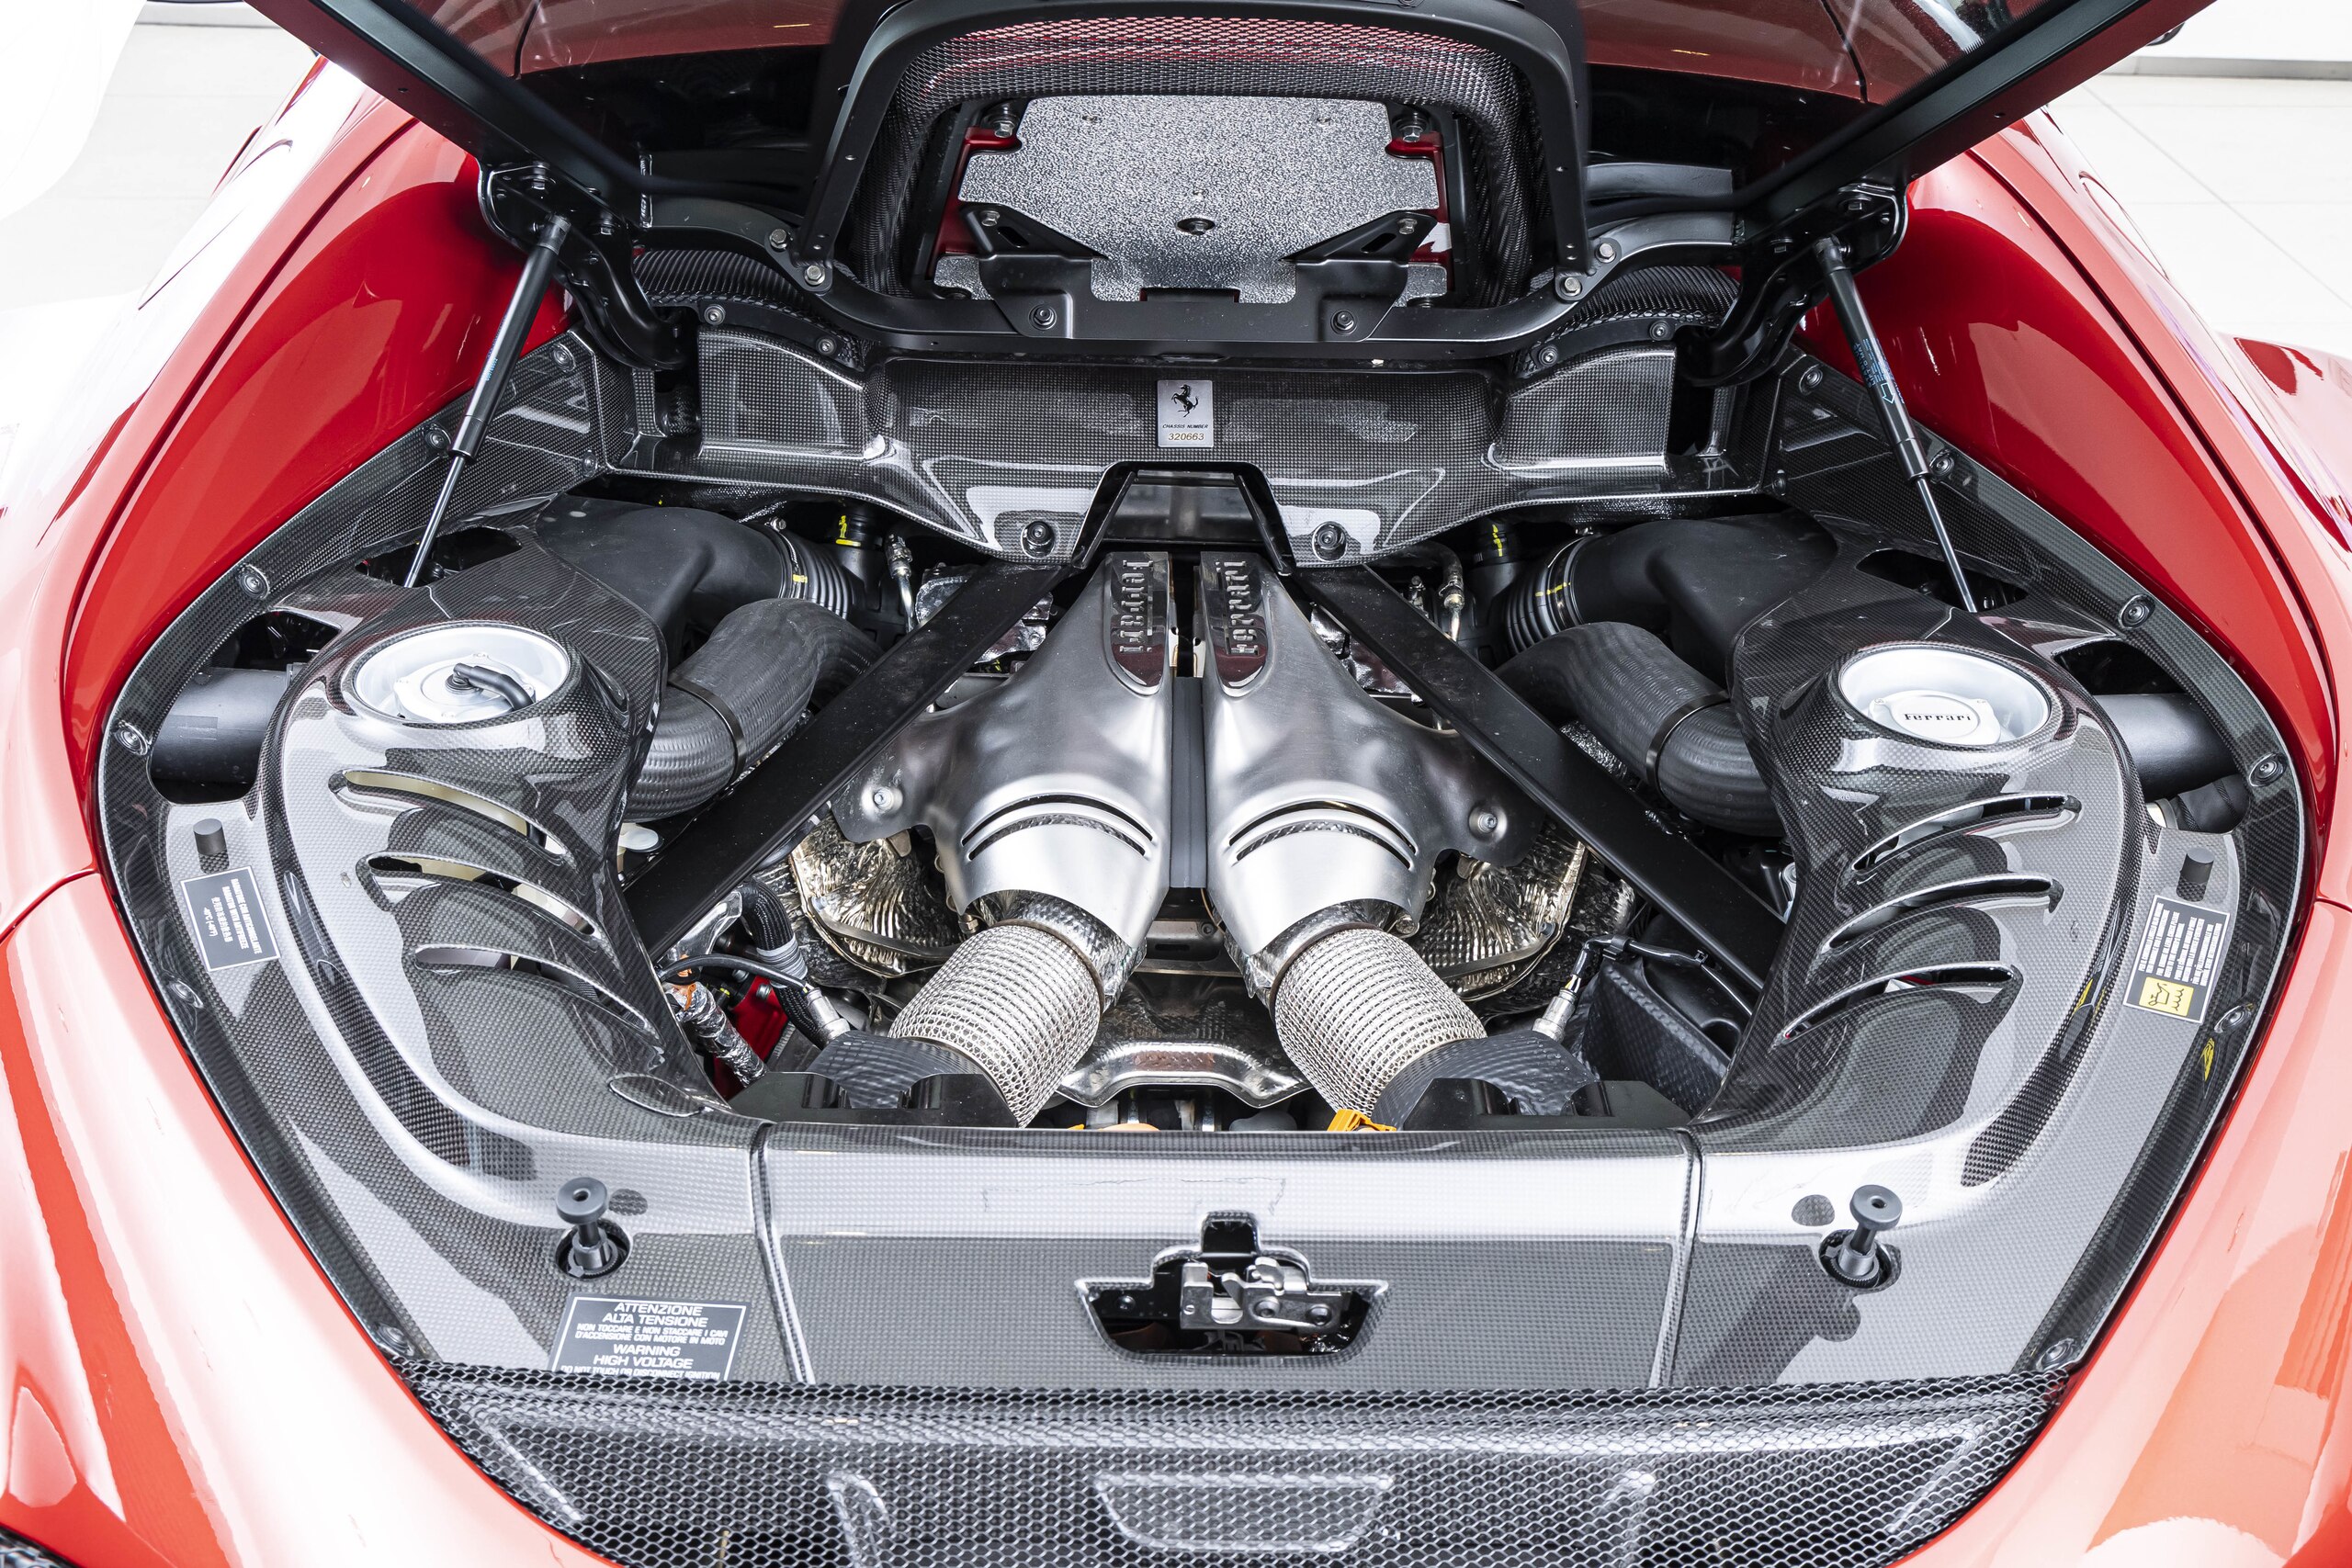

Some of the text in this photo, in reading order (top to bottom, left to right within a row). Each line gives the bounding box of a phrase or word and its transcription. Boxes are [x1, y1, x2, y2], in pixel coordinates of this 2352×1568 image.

[1168, 433, 1204, 441] 320663
[1904, 713, 1972, 721] Ferrari
[614, 1303, 703, 1315] ATTENZIONE
[603, 1313, 708, 1327] ALTA TENSIONE
[598, 1325, 633, 1333] TOCCARE
[642, 1326, 661, 1335] NON
[662, 1327, 703, 1337] STACCARE
[575, 1331, 725, 1346] D'ACCENSIONE CON MOTORE IN MOTO
[613, 1344, 681, 1357] WARNING
[594, 1355, 694, 1369] HIGH VOLTAGE
